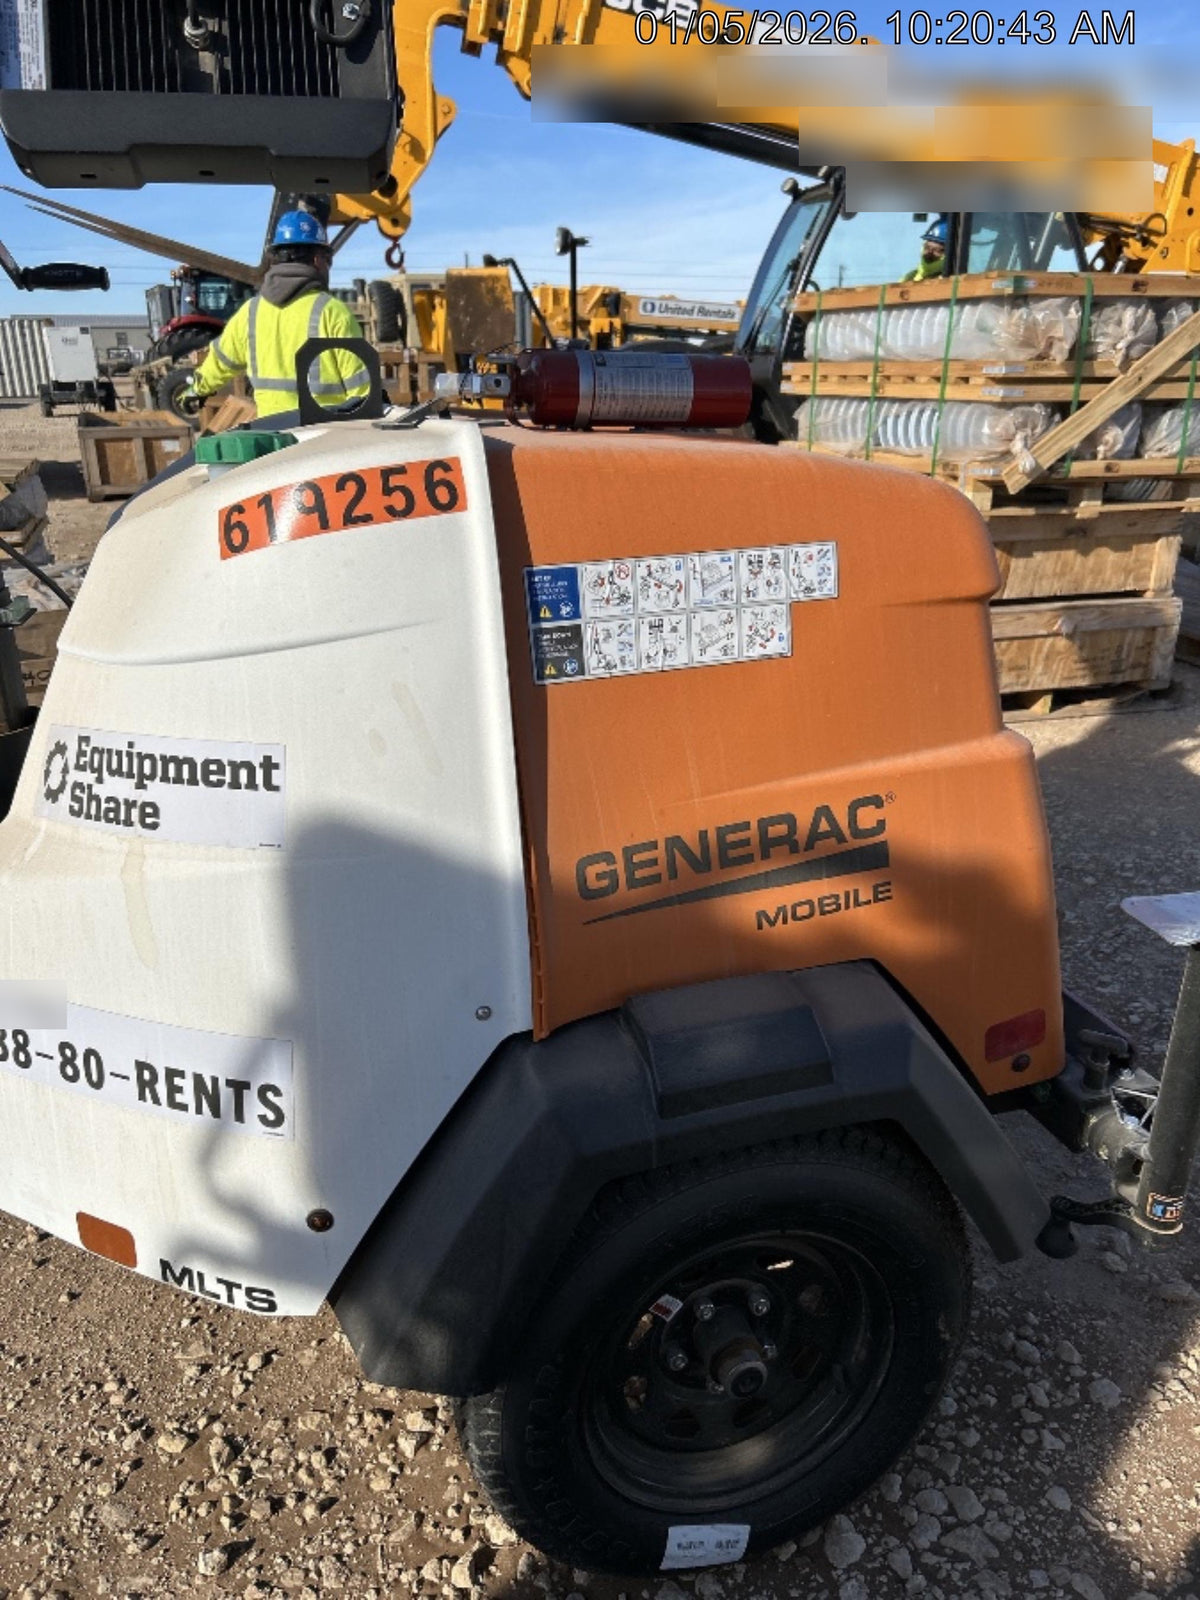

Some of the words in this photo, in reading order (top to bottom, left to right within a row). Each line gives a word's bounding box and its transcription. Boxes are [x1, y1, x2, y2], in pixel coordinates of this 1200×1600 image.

[658, 302, 695, 317] United
[697, 304, 737, 319] Rentals
[223, 460, 459, 554] 619256
[74, 735, 281, 792] Equipment
[68, 780, 161, 831] Share
[575, 794, 887, 900] GENERAC
[755, 881, 893, 930] MOBILE
[159, 1258, 278, 1313] MLTS
